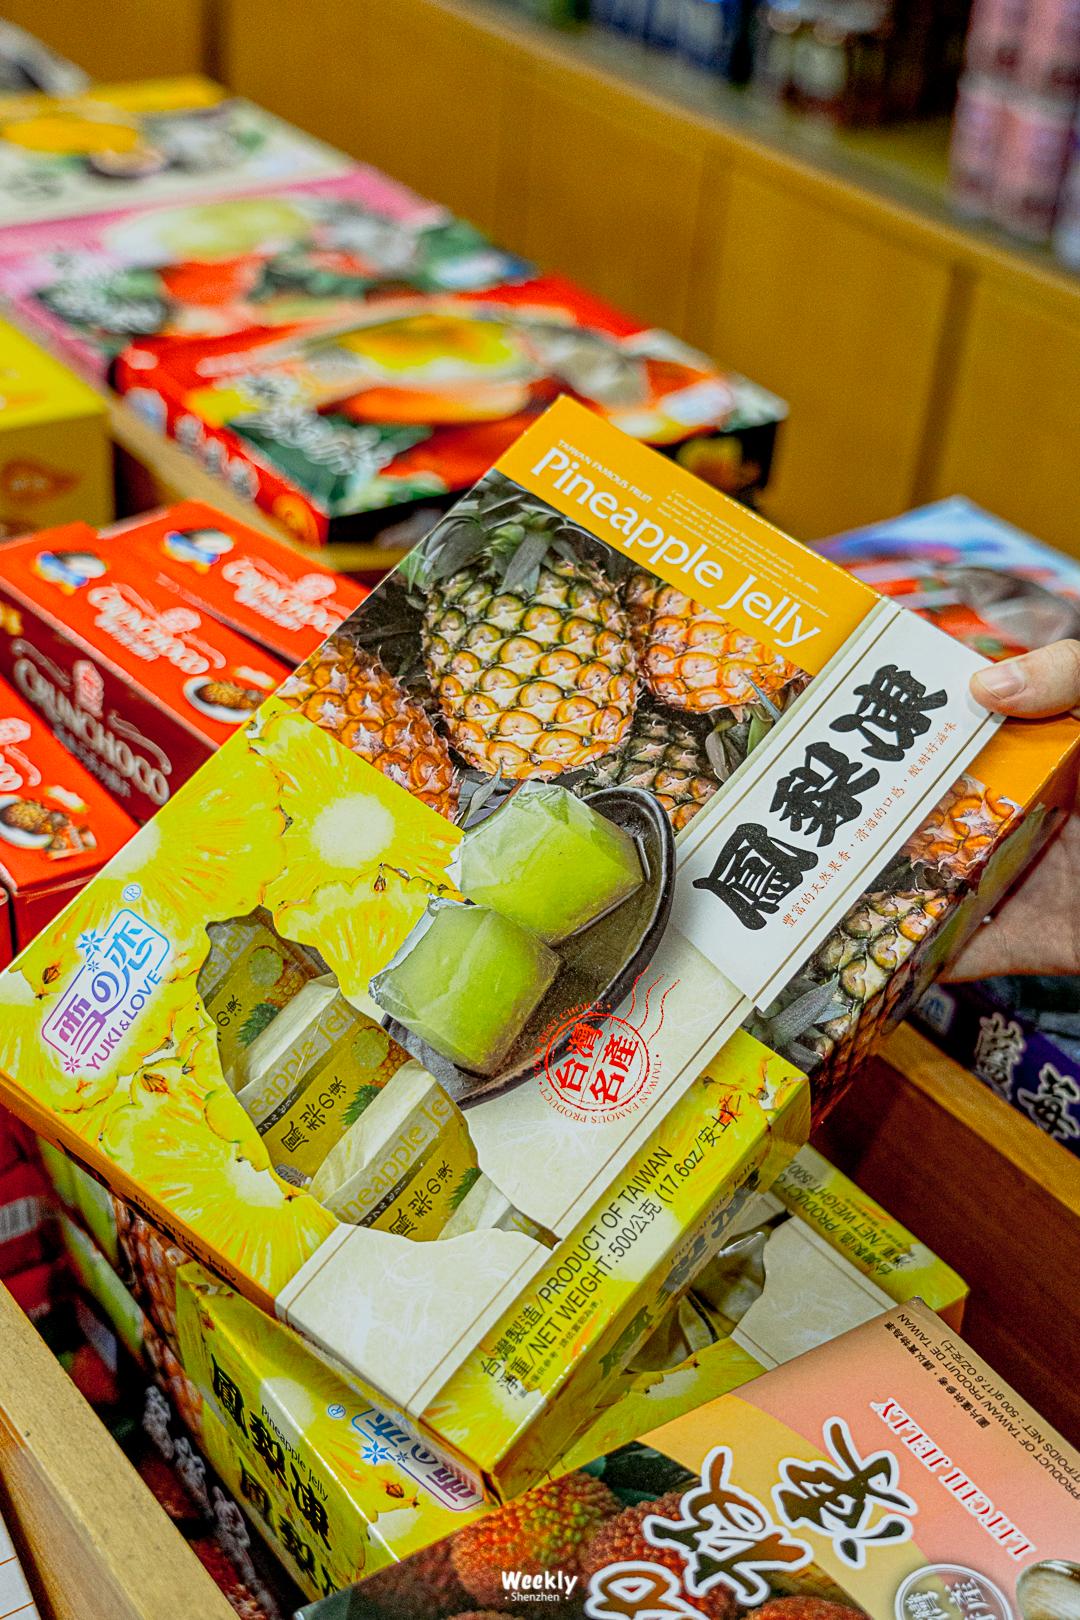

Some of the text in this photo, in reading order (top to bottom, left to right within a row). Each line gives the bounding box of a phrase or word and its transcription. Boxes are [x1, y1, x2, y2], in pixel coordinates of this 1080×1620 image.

[556, 439, 653, 504] TAIWAN FAMOUS FRUIT
[530, 447, 724, 589] Pineapple
[717, 574, 821, 648] Jelly
[693, 664, 948, 931] 鳳梨凍
[86, 1027, 123, 1071] YUKI
[123, 969, 163, 1021] LOVE
[589, 1033, 639, 1104] 名產
[643, 1060, 662, 1107] TAIWAN
[538, 1088, 587, 1124] PRODUCT
[597, 1200, 627, 1231] OF
[617, 1143, 674, 1206] TAIWAN
[494, 1317, 565, 1396] 淨重/NET
[896, 1311, 932, 1348] TAIWAN
[928, 1344, 946, 1363] DE
[942, 1358, 985, 1403] PRODUIT
[999, 1401, 1021, 1419] 500
[870, 1397, 954, 1473] JELLY
[981, 1398, 1021, 1440] TAIWAN/
[1019, 1438, 1036, 1453] OF
[1021, 1423, 1046, 1445] NET
[262, 1404, 329, 1502] Pineapple Jelly
[939, 1466, 1037, 1561] LITCHI
